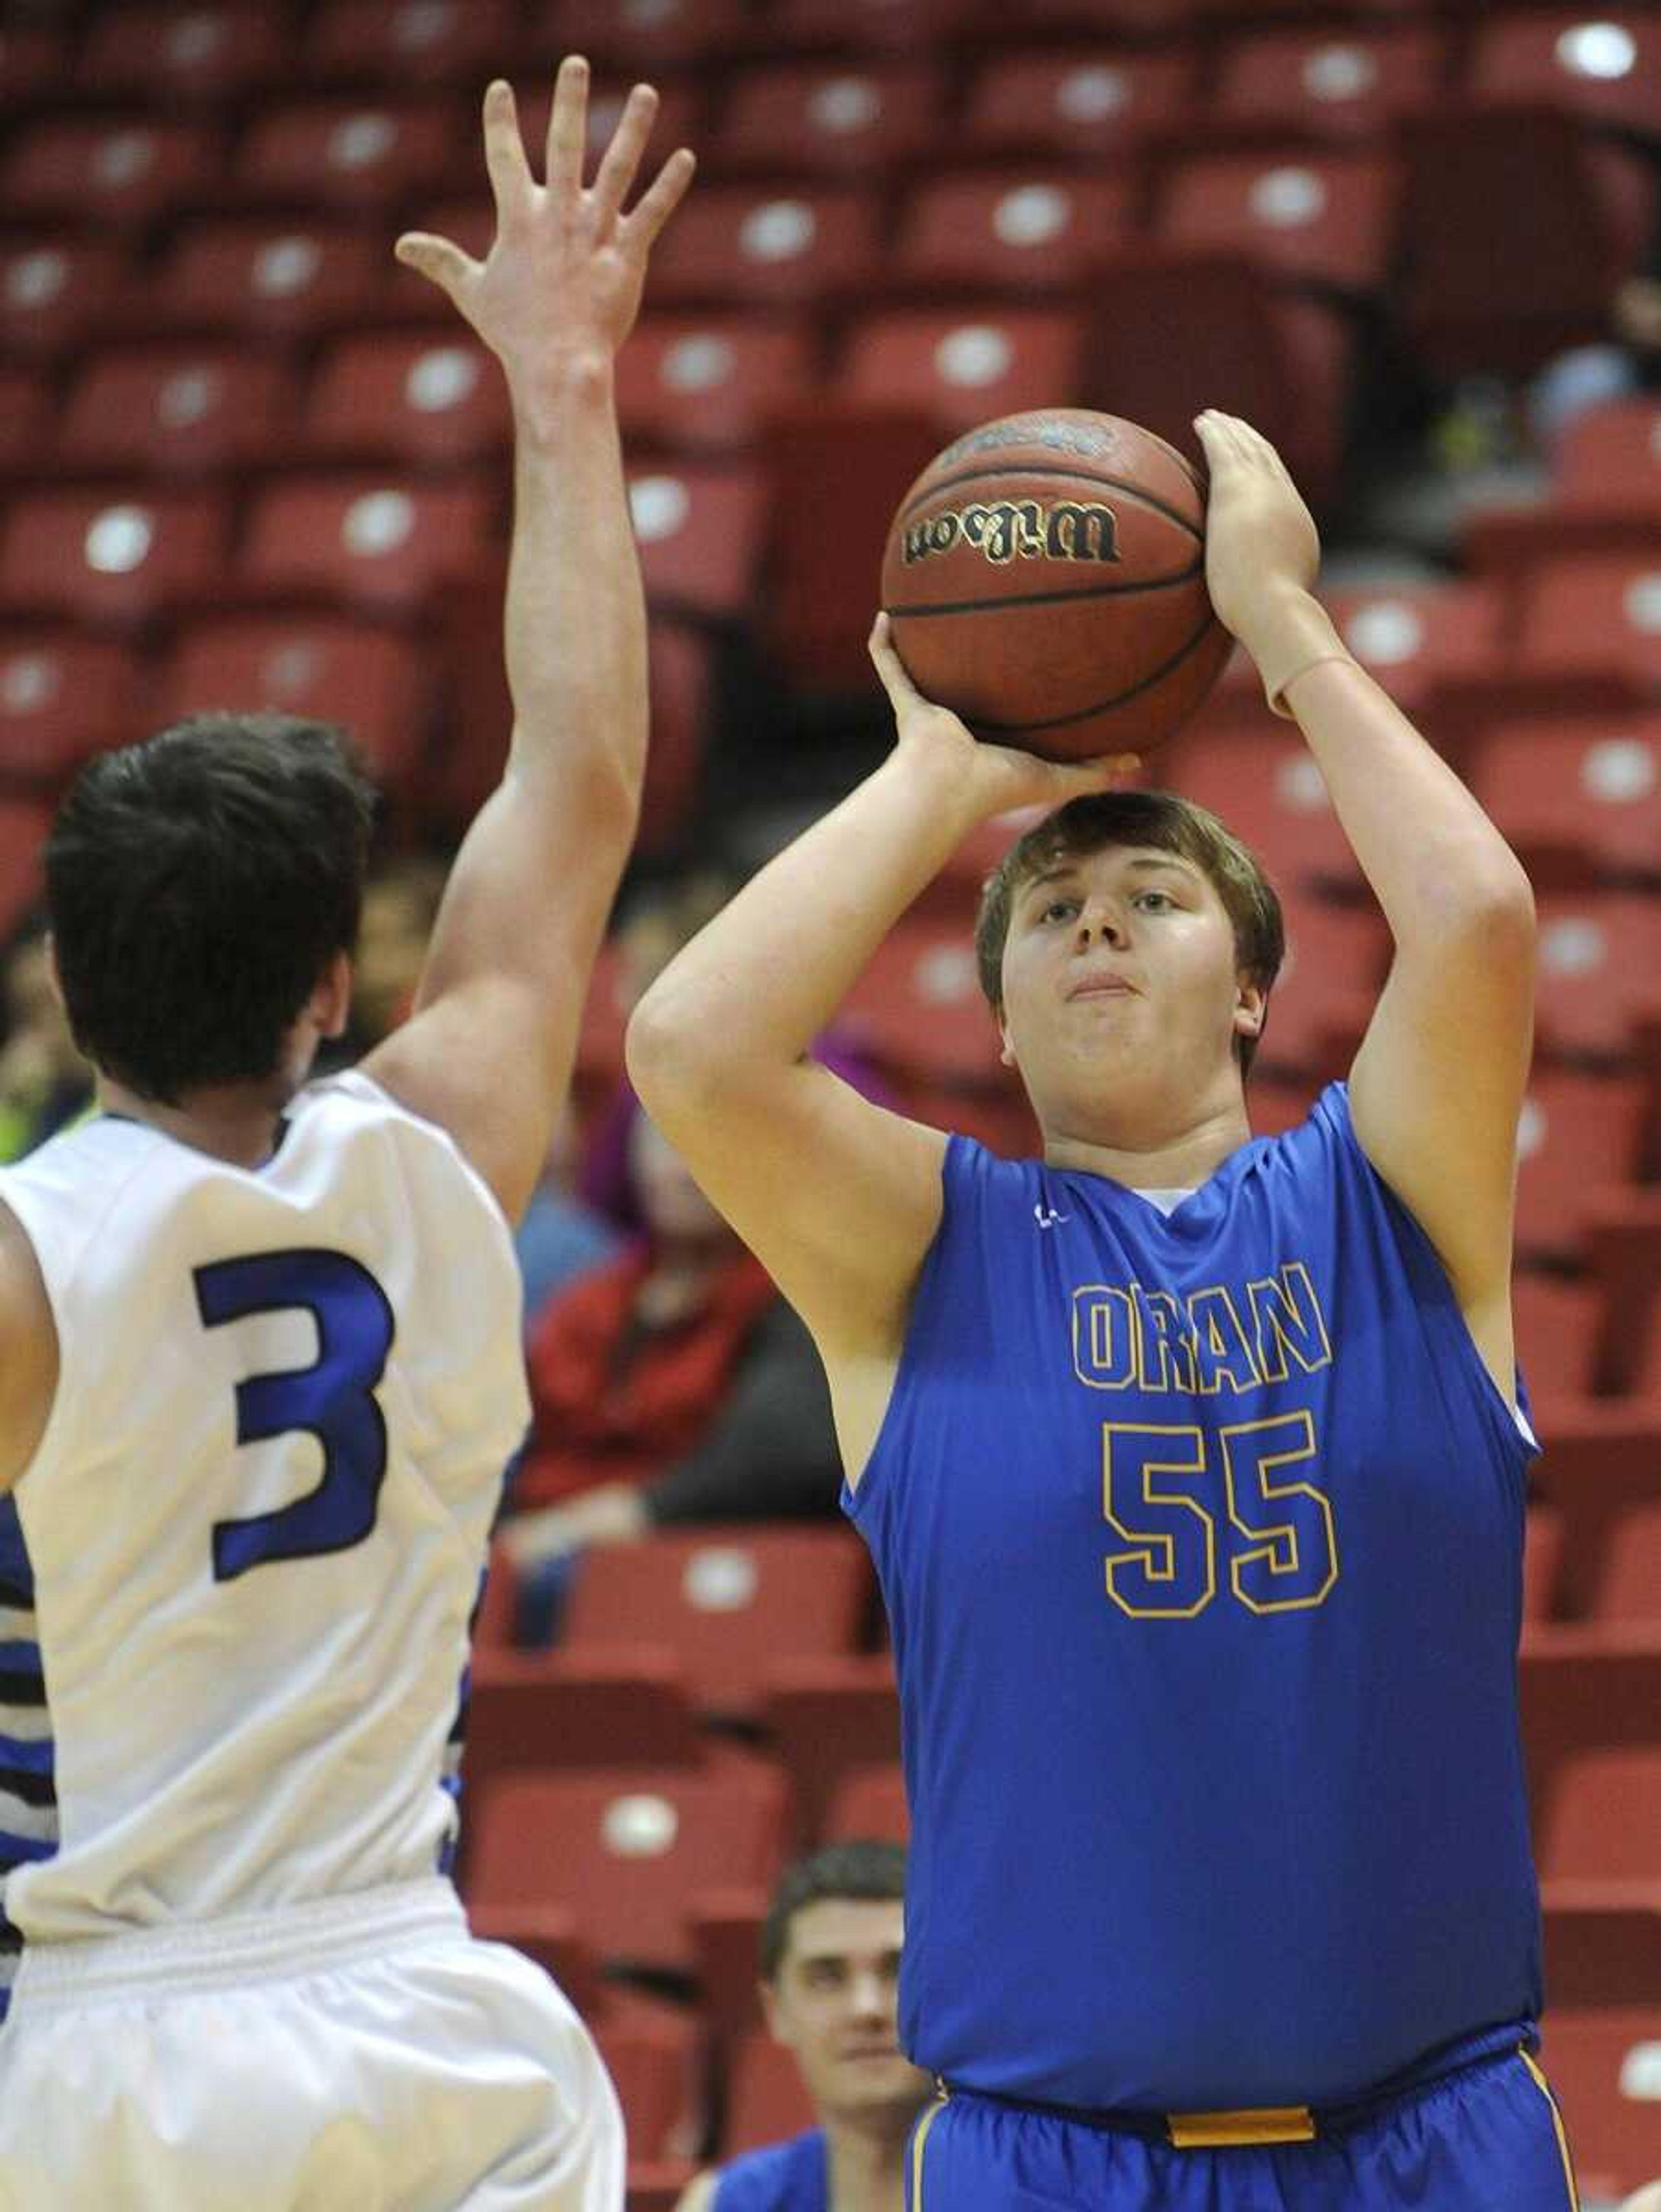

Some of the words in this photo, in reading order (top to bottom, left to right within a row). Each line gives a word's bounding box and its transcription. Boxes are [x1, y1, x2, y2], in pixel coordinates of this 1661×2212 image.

[902, 499, 1122, 565] Wilson
[1072, 1262, 1333, 1394] ORAN
[192, 1247, 395, 1582] 3
[1103, 1410, 1339, 1618] 55
